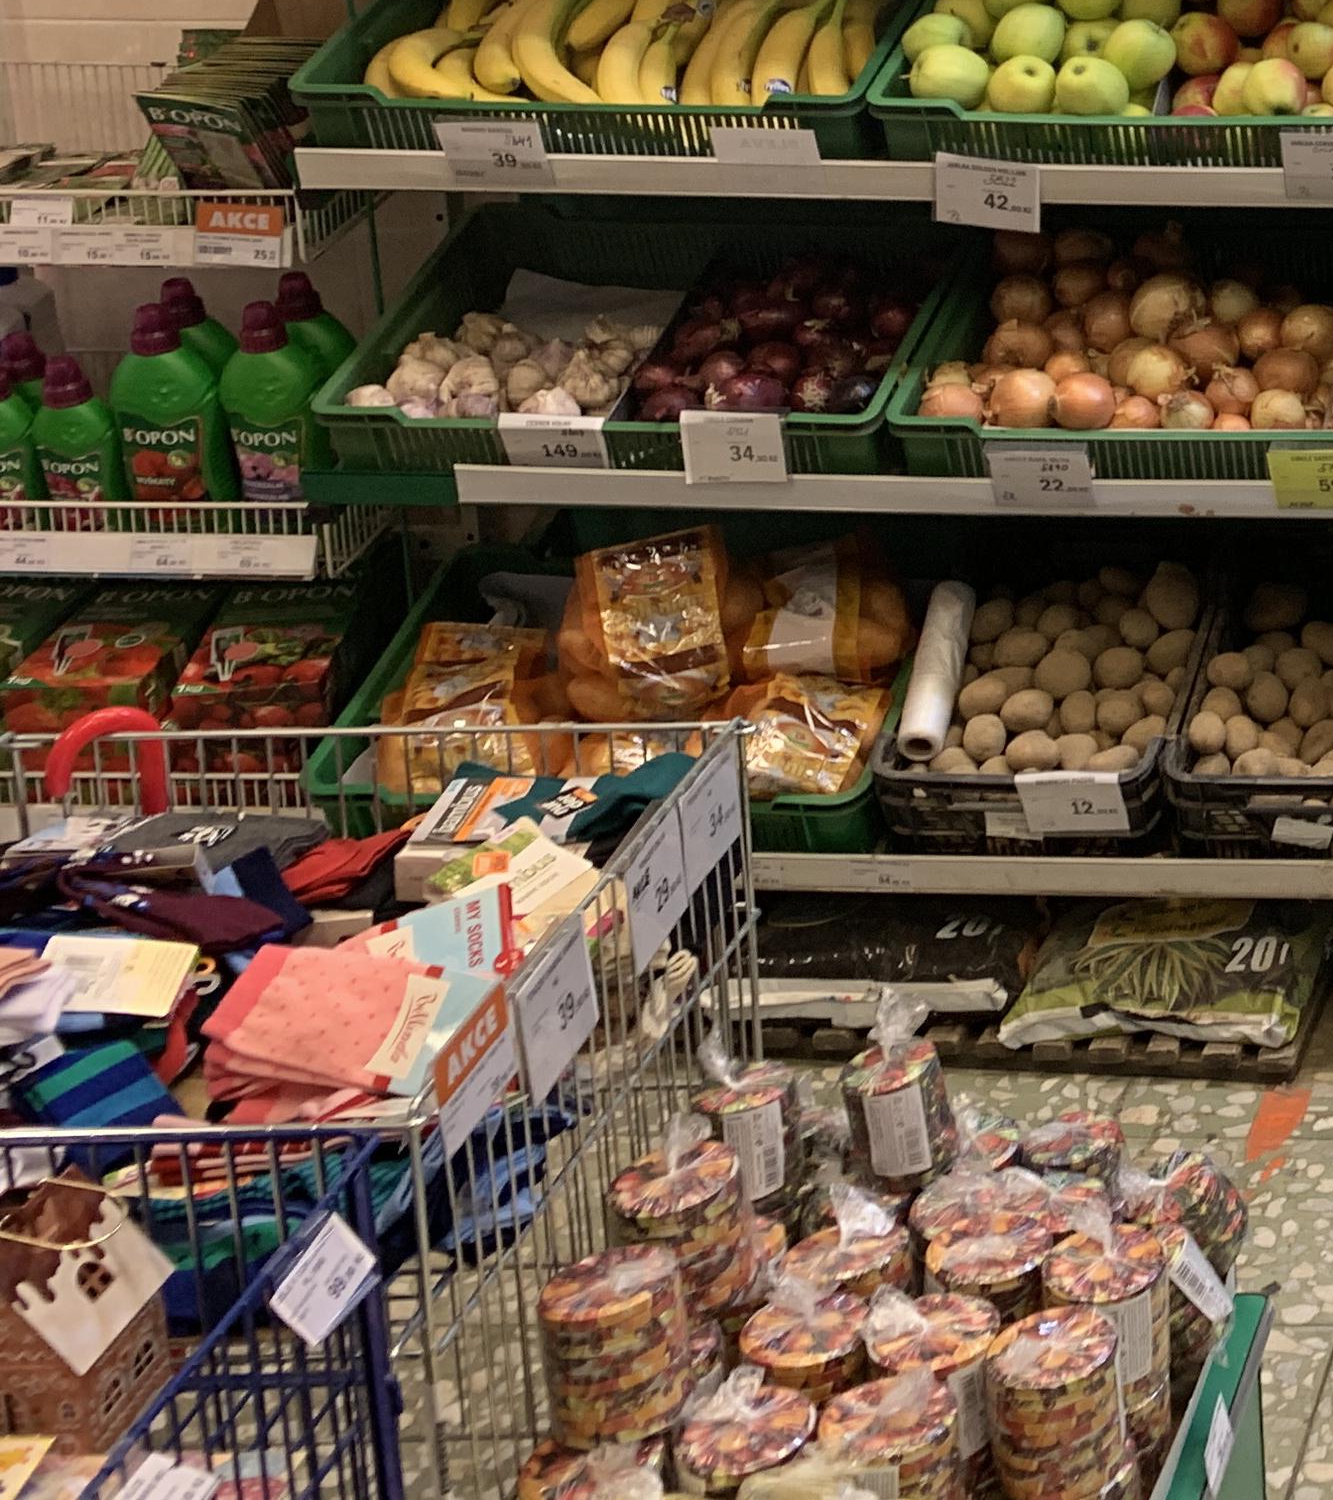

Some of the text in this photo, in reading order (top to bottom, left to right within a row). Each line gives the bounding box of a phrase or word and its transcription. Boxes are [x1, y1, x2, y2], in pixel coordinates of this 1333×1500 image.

[491, 152, 517, 168] 39
[209, 210, 270, 230] AKCE
[541, 443, 578, 458] 149
[729, 445, 755, 462] 34
[1039, 480, 1064, 492] 22
[1070, 800, 1095, 815] 12
[465, 899, 484, 969] MY SOCKS
[558, 992, 574, 1030] 39
[448, 1004, 499, 1085] AKCE
